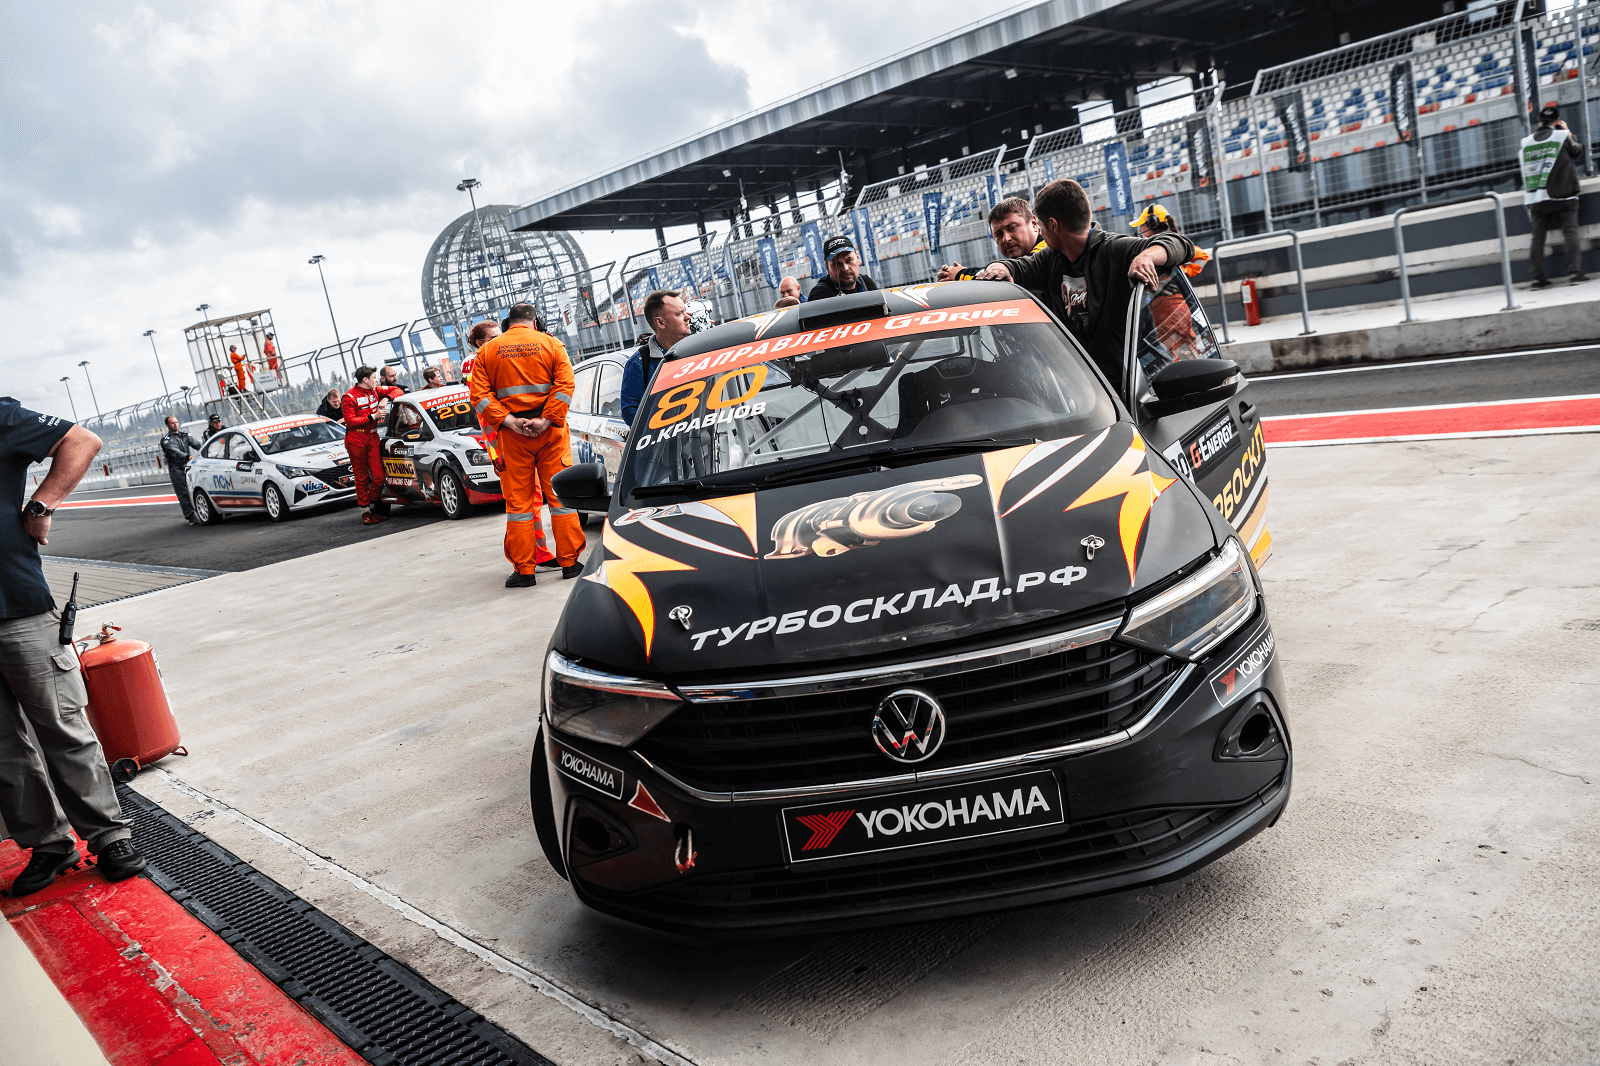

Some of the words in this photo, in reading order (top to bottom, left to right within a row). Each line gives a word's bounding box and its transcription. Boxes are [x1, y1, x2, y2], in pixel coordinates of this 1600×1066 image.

[672, 322, 871, 379] ЗАПРАВЛЕНО
[437, 402, 471, 420] 20
[648, 365, 768, 430] 80
[635, 402, 767, 451] О.КРАВЦОВ
[385, 462, 415, 475] TUNING
[689, 565, 1088, 651] ТУРБОСКЛАД.РФ
[561, 750, 615, 789] YOKOHAMA
[856, 785, 1050, 840] YOKOHAMA
